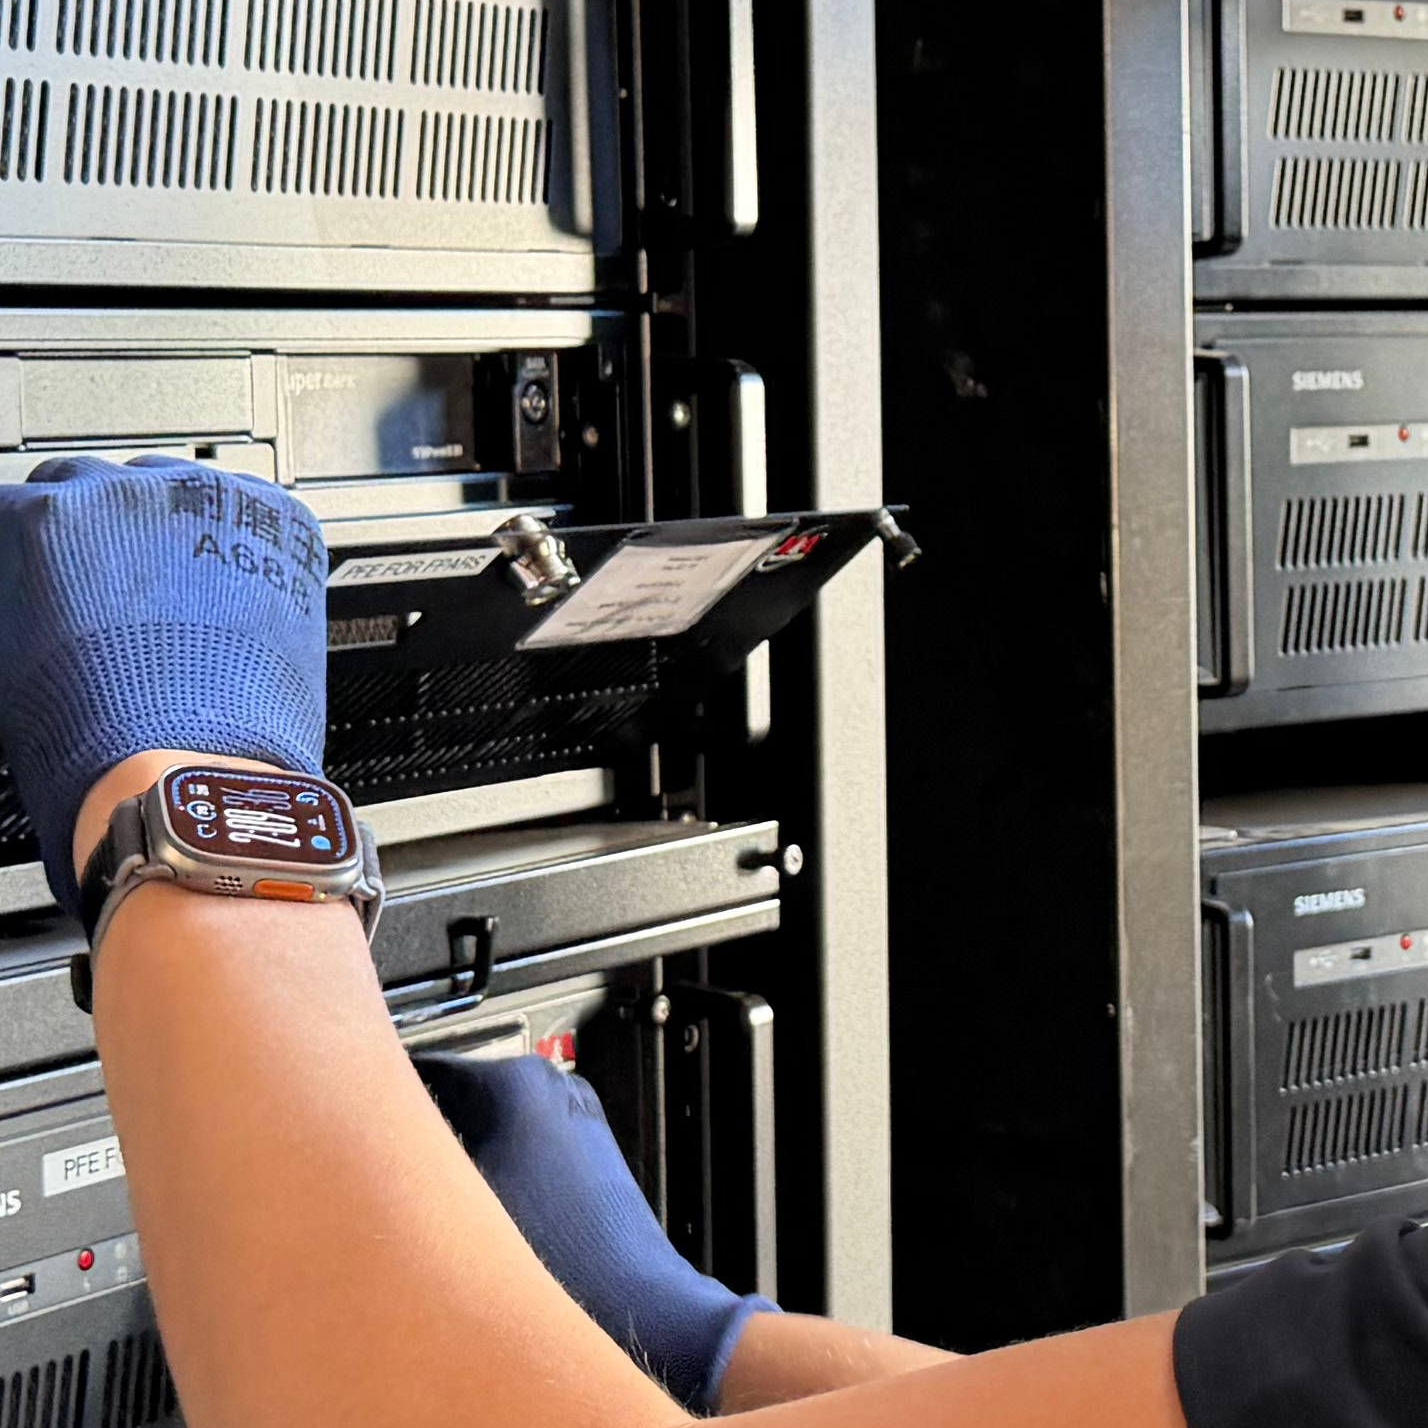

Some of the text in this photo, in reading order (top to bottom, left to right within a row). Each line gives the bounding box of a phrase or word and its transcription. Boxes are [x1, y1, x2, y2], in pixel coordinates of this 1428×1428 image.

[1292, 369, 1365, 392] SIEMENS
[341, 555, 486, 580] PFE FOR FPARS
[1294, 887, 1367, 917] SIEMENS
[63, 1146, 122, 1181] PFE F
